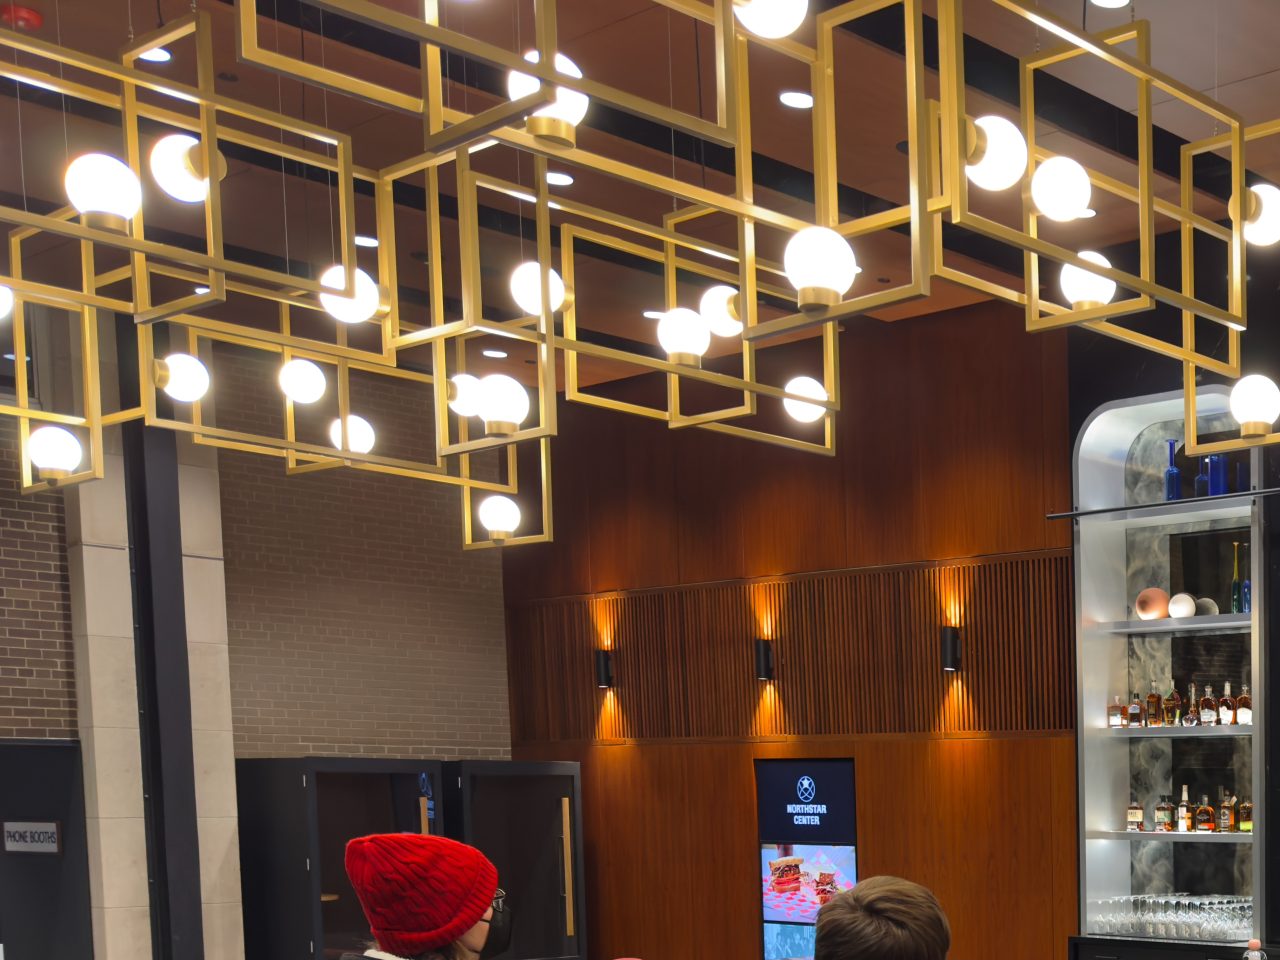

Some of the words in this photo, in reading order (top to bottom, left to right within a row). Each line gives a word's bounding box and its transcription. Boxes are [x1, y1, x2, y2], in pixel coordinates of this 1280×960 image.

[787, 804, 827, 814] NORTHSTAR
[794, 815, 820, 825] CENTER
[6, 830, 28, 843] PHONE
[30, 831, 56, 844] BOOTHS
